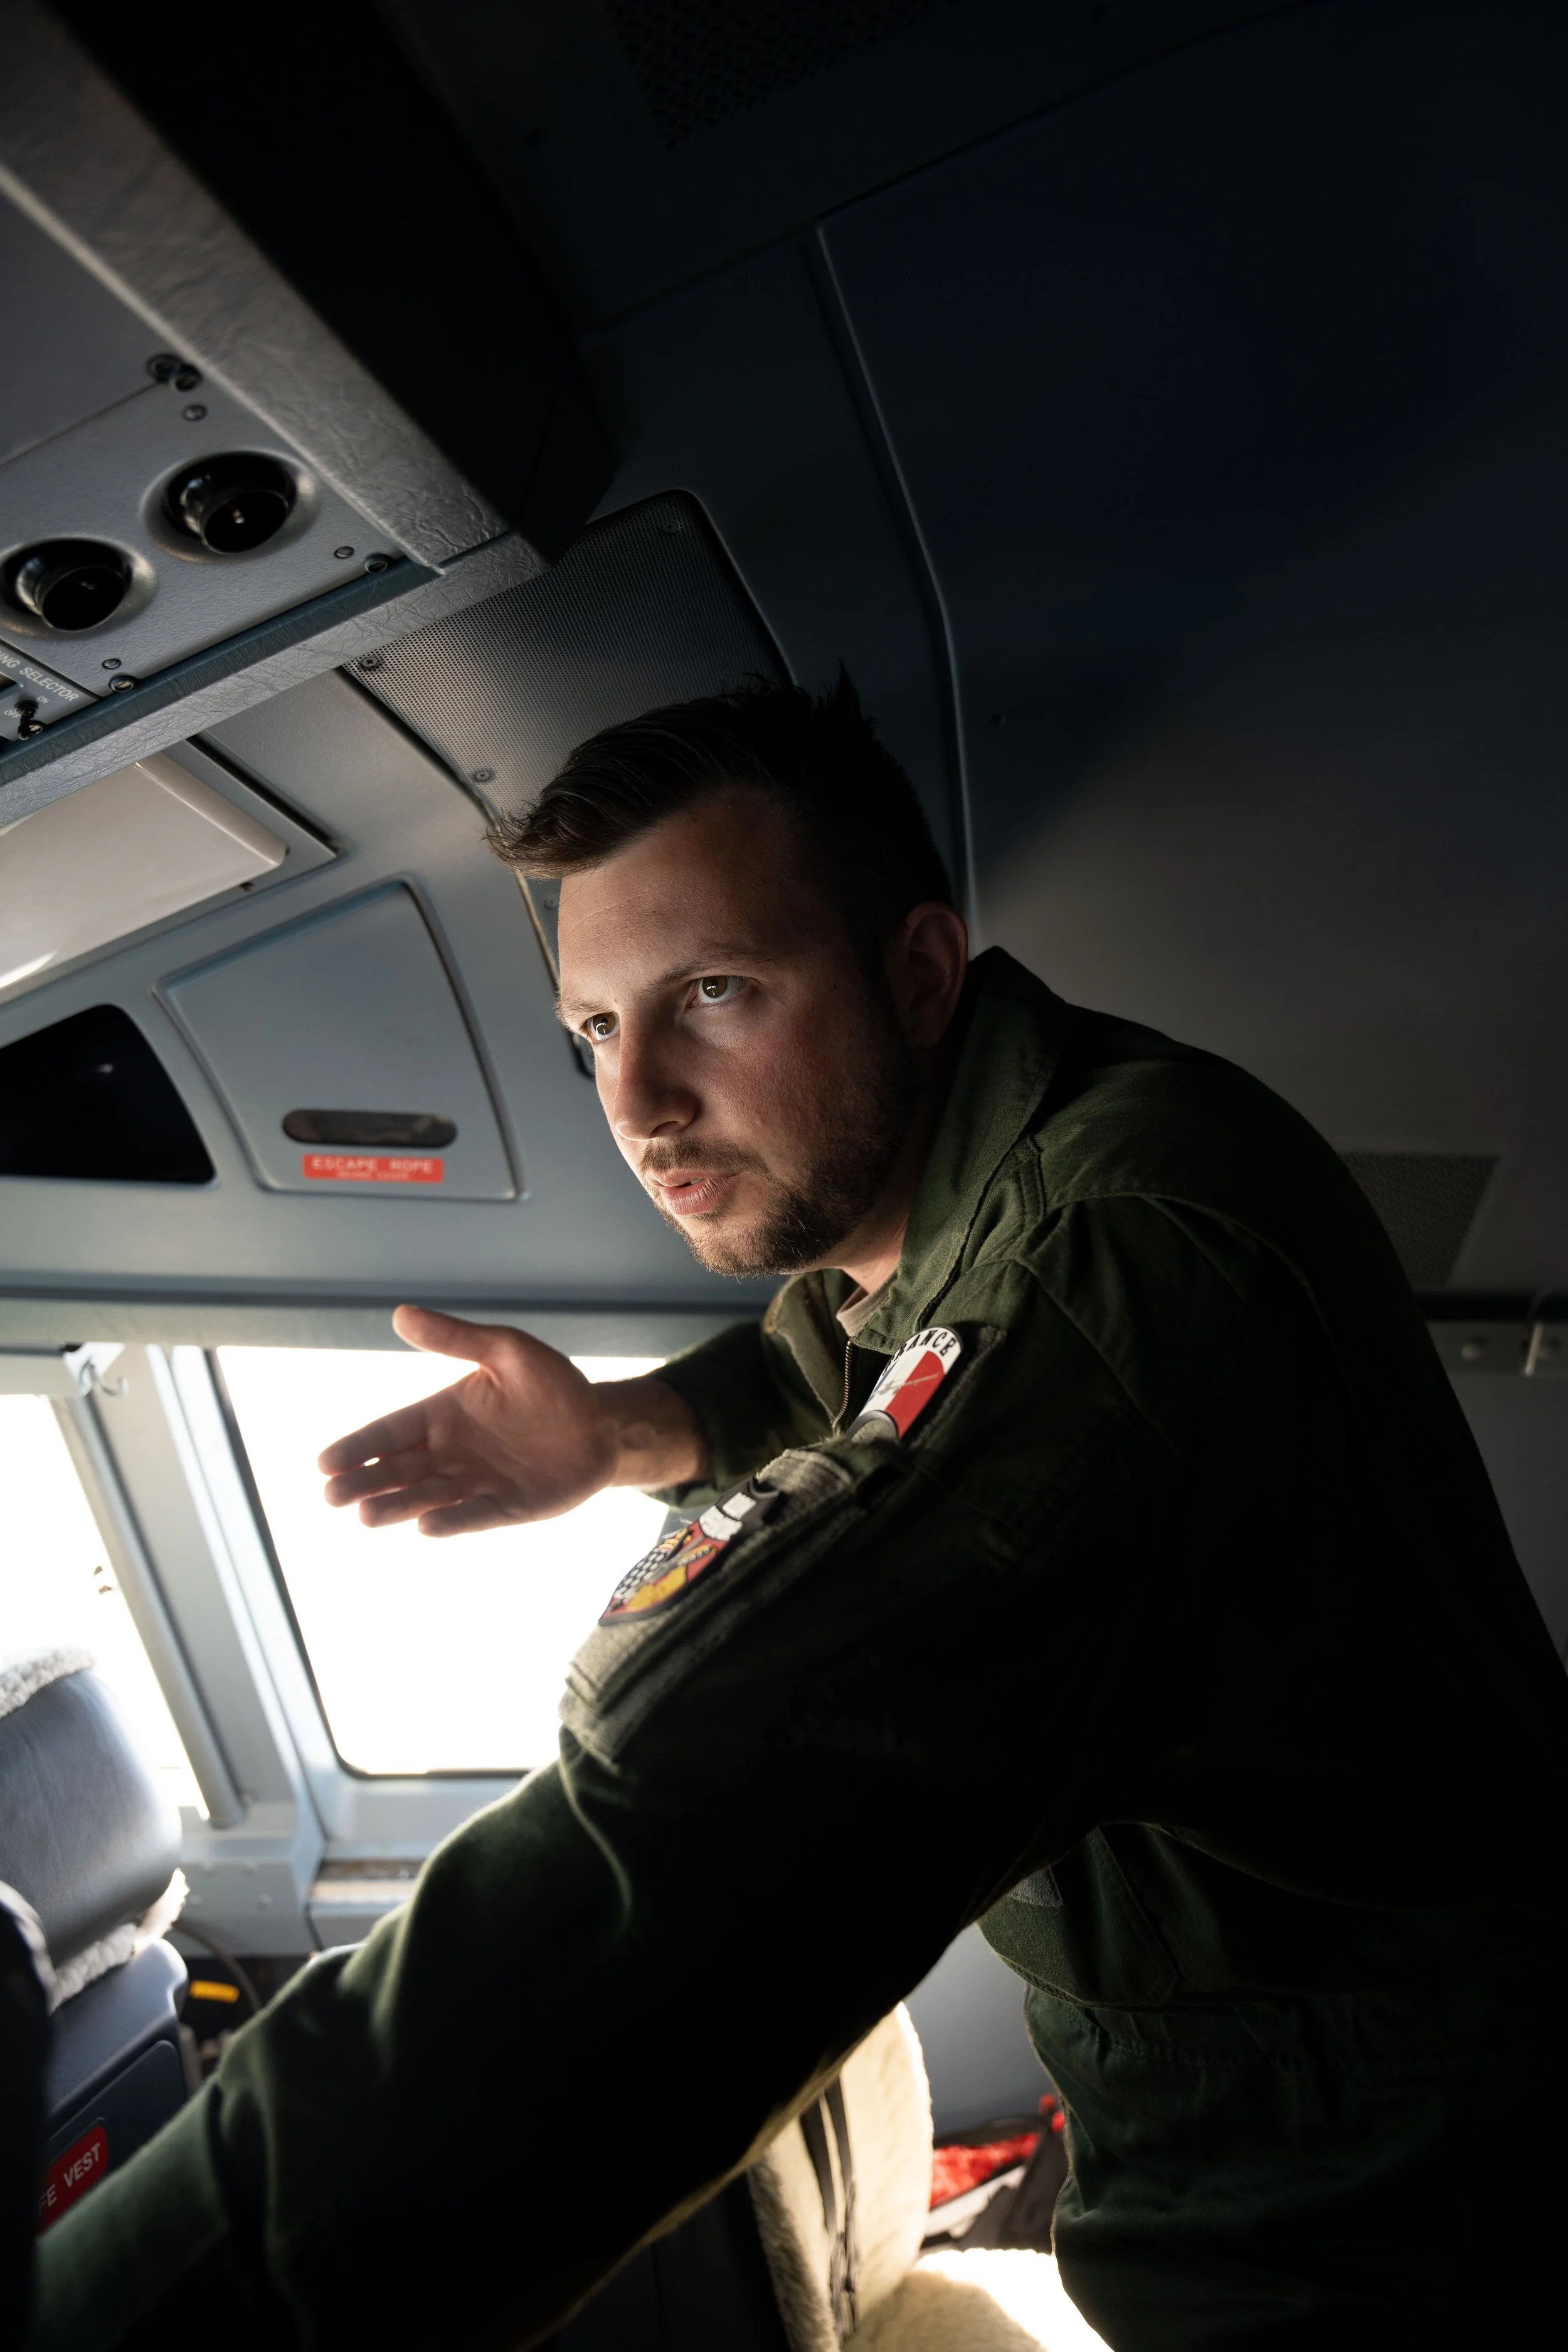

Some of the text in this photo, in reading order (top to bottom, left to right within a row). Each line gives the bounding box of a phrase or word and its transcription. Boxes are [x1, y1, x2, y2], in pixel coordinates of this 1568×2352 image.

[0, 650, 80, 702] ING SELECTOR
[37, 696, 51, 704] ON
[4, 709, 21, 718] OFF
[311, 1156, 434, 1174] ESCAPE ROPE
[63, 2142, 101, 2188] VEST
